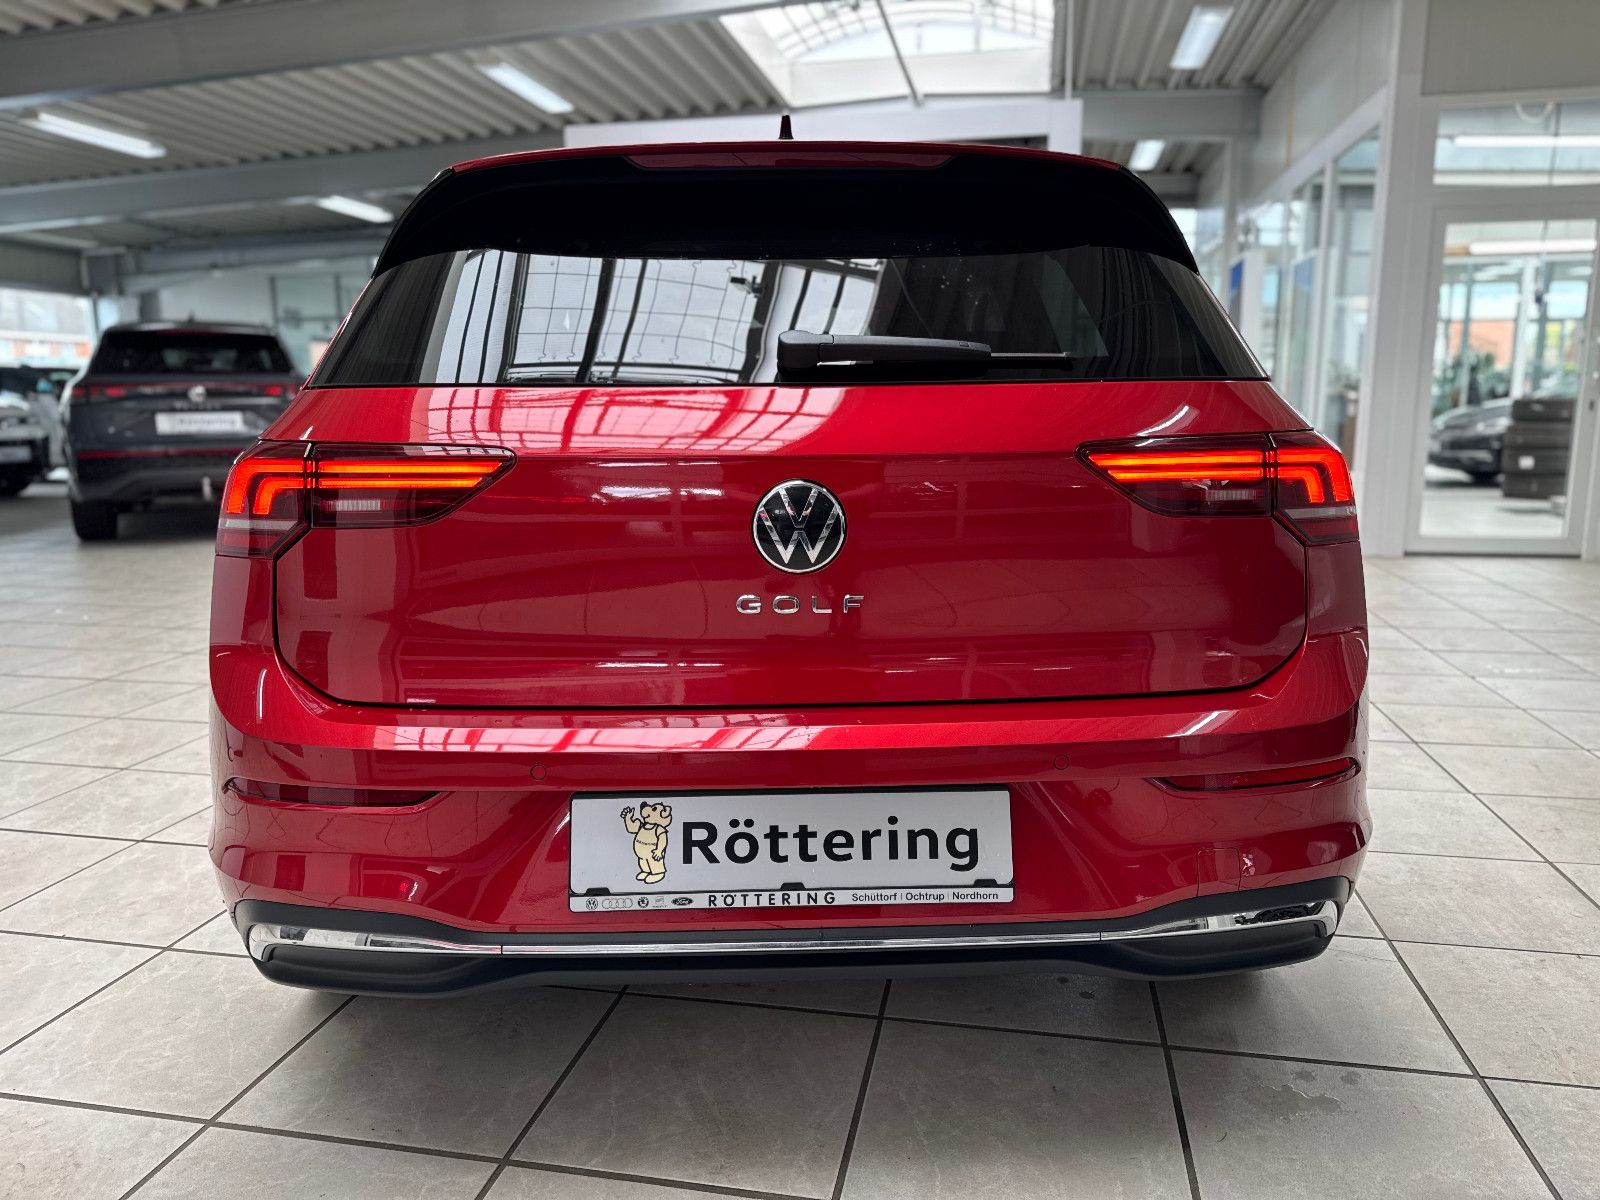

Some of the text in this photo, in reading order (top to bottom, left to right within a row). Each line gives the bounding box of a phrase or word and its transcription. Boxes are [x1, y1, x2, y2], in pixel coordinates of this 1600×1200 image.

[736, 594, 865, 614] GOLF
[682, 815, 979, 872] Röttering
[708, 891, 999, 907] RÖTTERING Schüttorf Ochtrup Nordhorn
